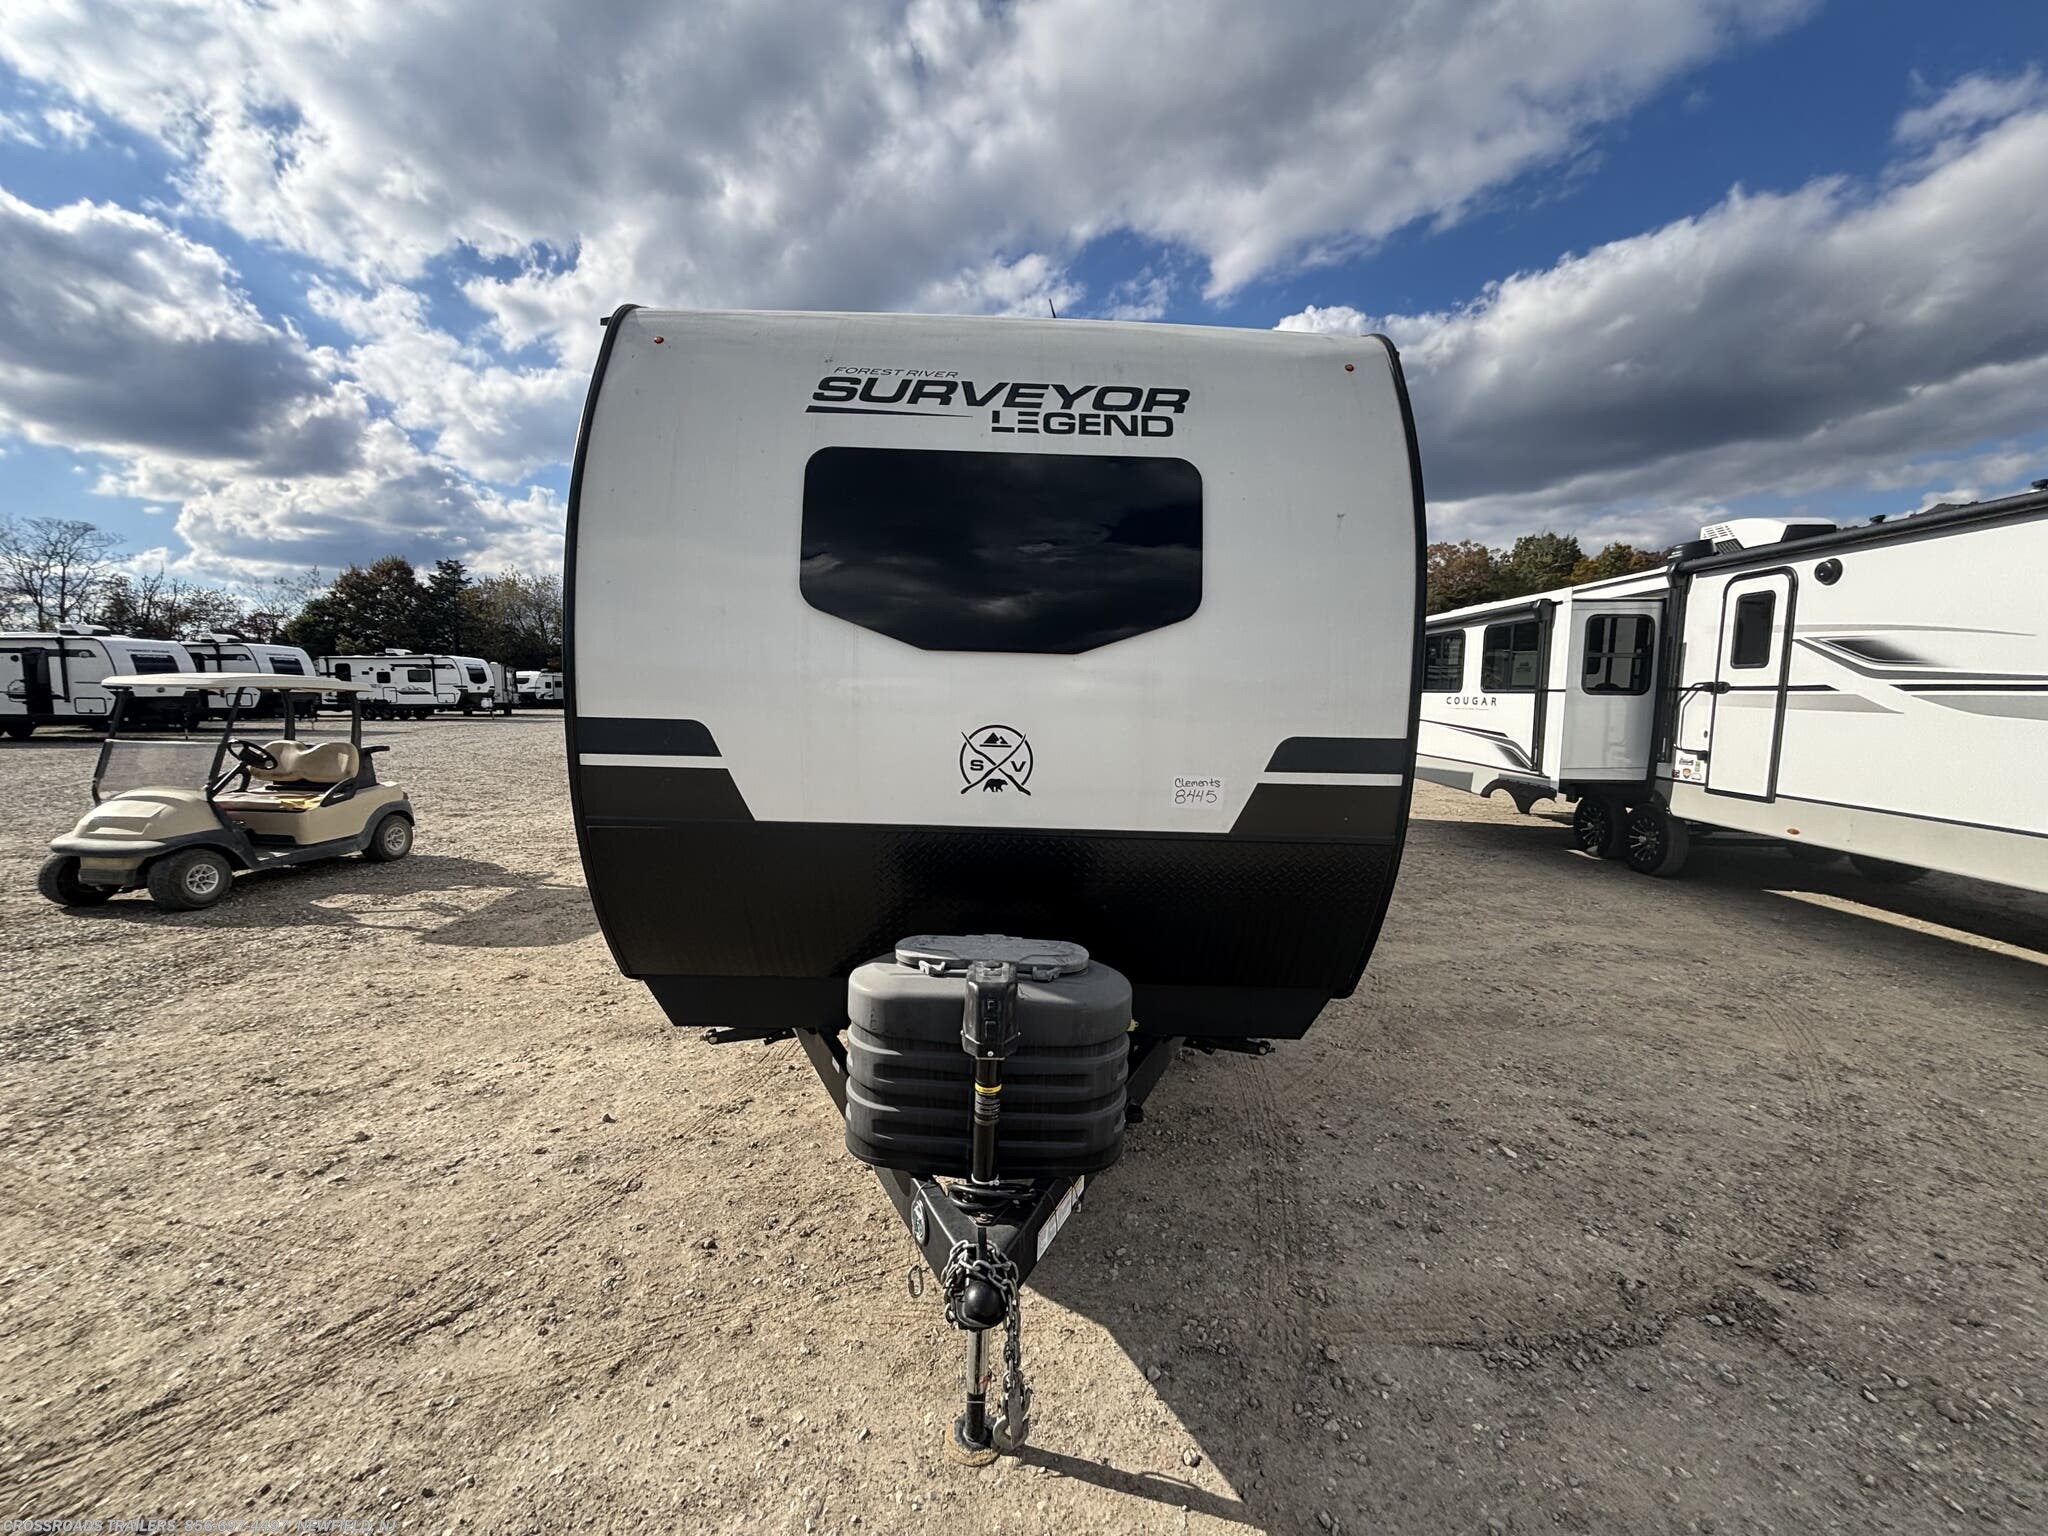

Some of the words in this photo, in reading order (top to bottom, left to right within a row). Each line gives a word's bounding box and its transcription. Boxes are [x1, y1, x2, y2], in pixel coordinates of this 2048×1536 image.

[834, 366, 904, 377] FOREST
[906, 370, 959, 379] RIVER
[812, 376, 1191, 414] SURVEYOR
[991, 410, 1174, 437] LEGEND
[1446, 696, 1497, 706] COUGAR
[1175, 778, 1221, 788] Clements
[1175, 789, 1217, 804] 8445
